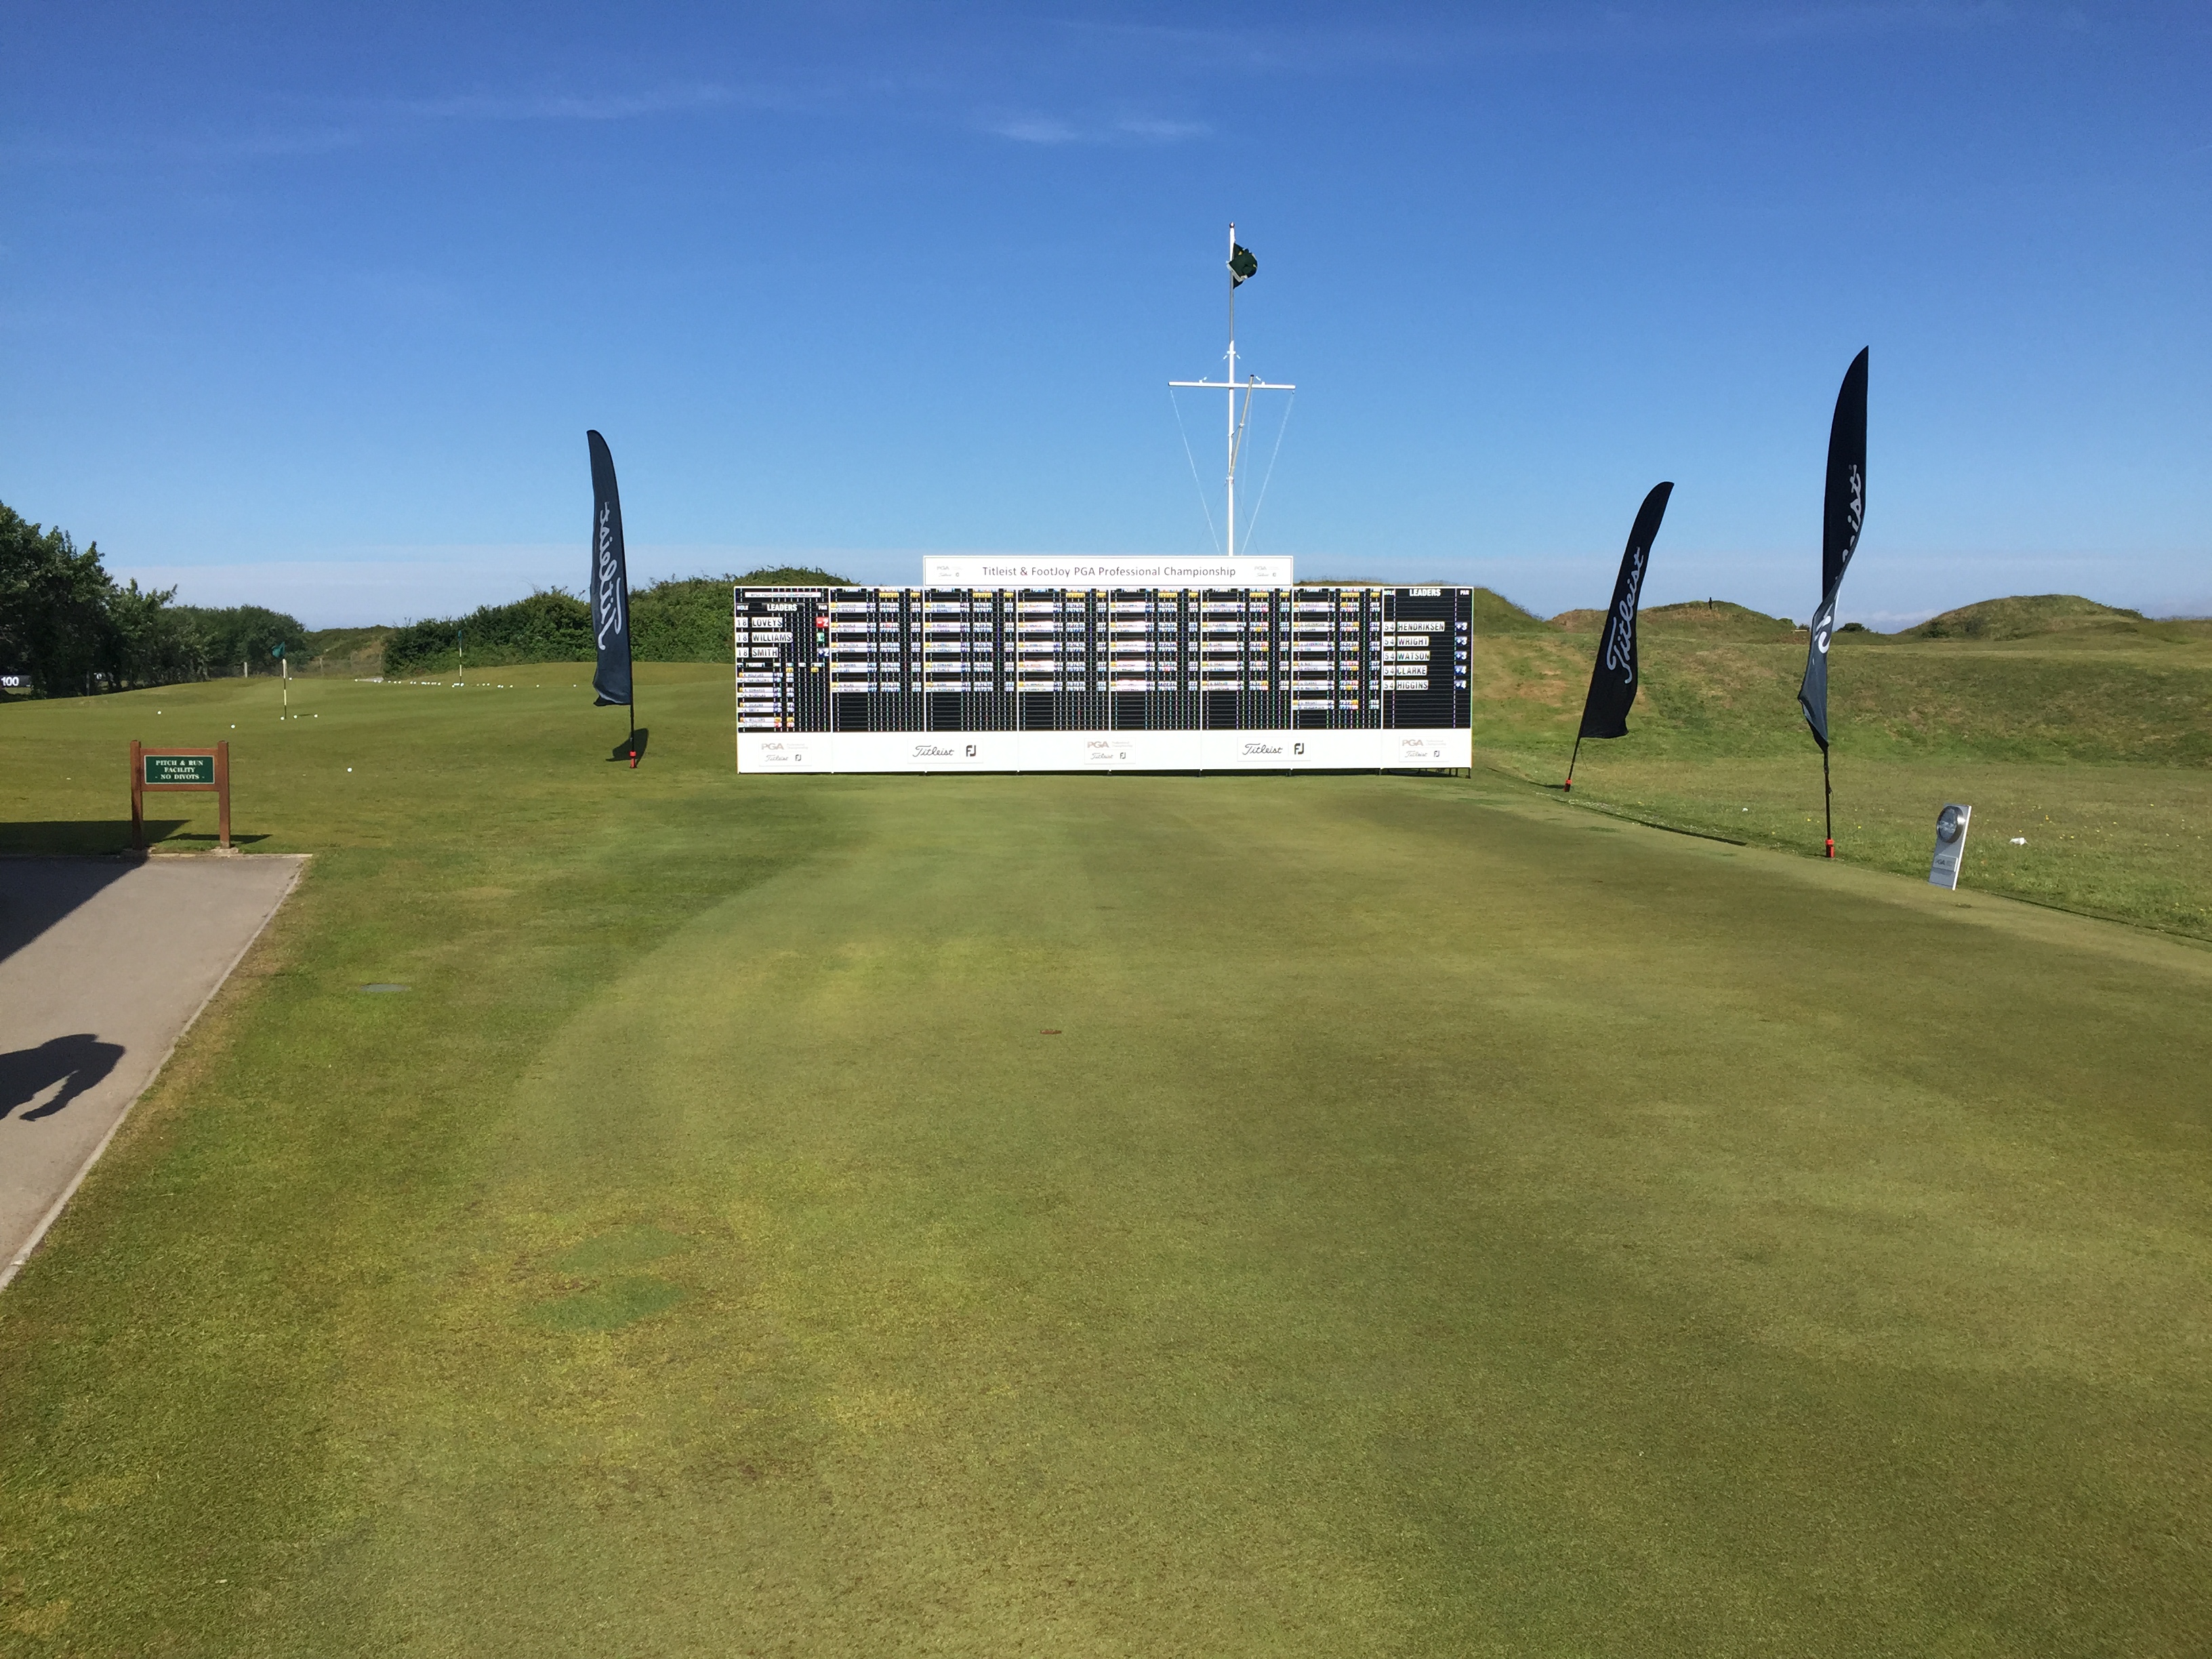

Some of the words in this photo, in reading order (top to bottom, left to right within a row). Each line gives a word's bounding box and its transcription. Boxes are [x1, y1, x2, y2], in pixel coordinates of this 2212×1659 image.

[982, 566, 1017, 576] Titleist
[1020, 567, 1028, 576] &
[1031, 567, 1071, 578] FootJoy
[1074, 567, 1096, 576] PGA
[1099, 566, 1160, 576] Professional
[1164, 566, 1236, 578] Championship
[1409, 588, 1441, 597] LEADERS
[766, 603, 798, 611] LEADERS
[1606, 546, 1644, 684] Titleist
[737, 619, 747, 627] 18
[752, 619, 783, 627] LOVEYS
[1397, 623, 1444, 631] HENDRIKSEN
[1456, 622, 1467, 631] +3
[737, 634, 747, 642] 18
[752, 634, 792, 642] WILLIAMS
[1456, 637, 1467, 646] +3
[738, 649, 747, 657] 18
[752, 649, 777, 657] SMITH
[818, 649, 829, 657] +2
[1456, 652, 1467, 660] +3
[1455, 666, 1467, 674] +4
[1, 676, 20, 687] 100
[1384, 681, 1394, 689] 54
[1397, 681, 1428, 689] HIGGINS
[1455, 680, 1467, 689] +4
[1087, 741, 1109, 749] PGA
[1401, 739, 1424, 747] PGA
[912, 745, 955, 758] Titleist
[966, 744, 977, 757] FJ
[1242, 743, 1284, 756] Titleist
[1294, 742, 1305, 755] FJ
